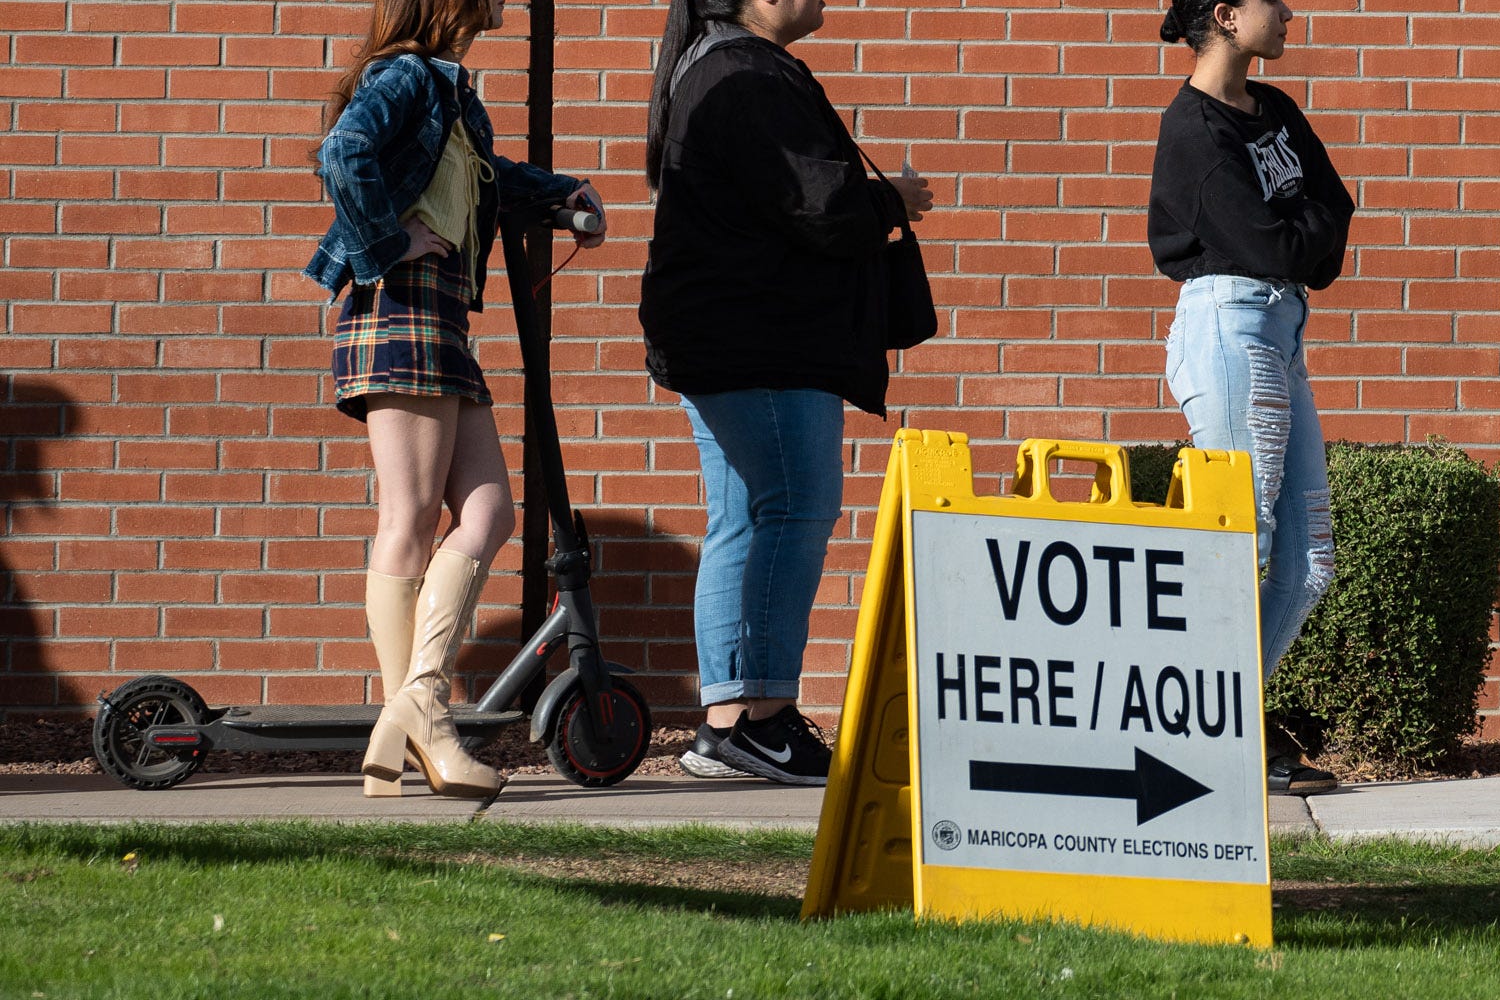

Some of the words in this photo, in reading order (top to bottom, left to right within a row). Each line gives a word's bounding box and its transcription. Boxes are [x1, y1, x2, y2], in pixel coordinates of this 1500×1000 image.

[985, 538, 1187, 632] VOTE
[936, 652, 1077, 728] HERE
[1119, 665, 1243, 739] AQUI
[967, 828, 1048, 850] MARICOPA
[1053, 834, 1117, 854] COUNTY
[1123, 838, 1209, 860] ELECTIONS
[1214, 843, 1258, 862] DEPT.
